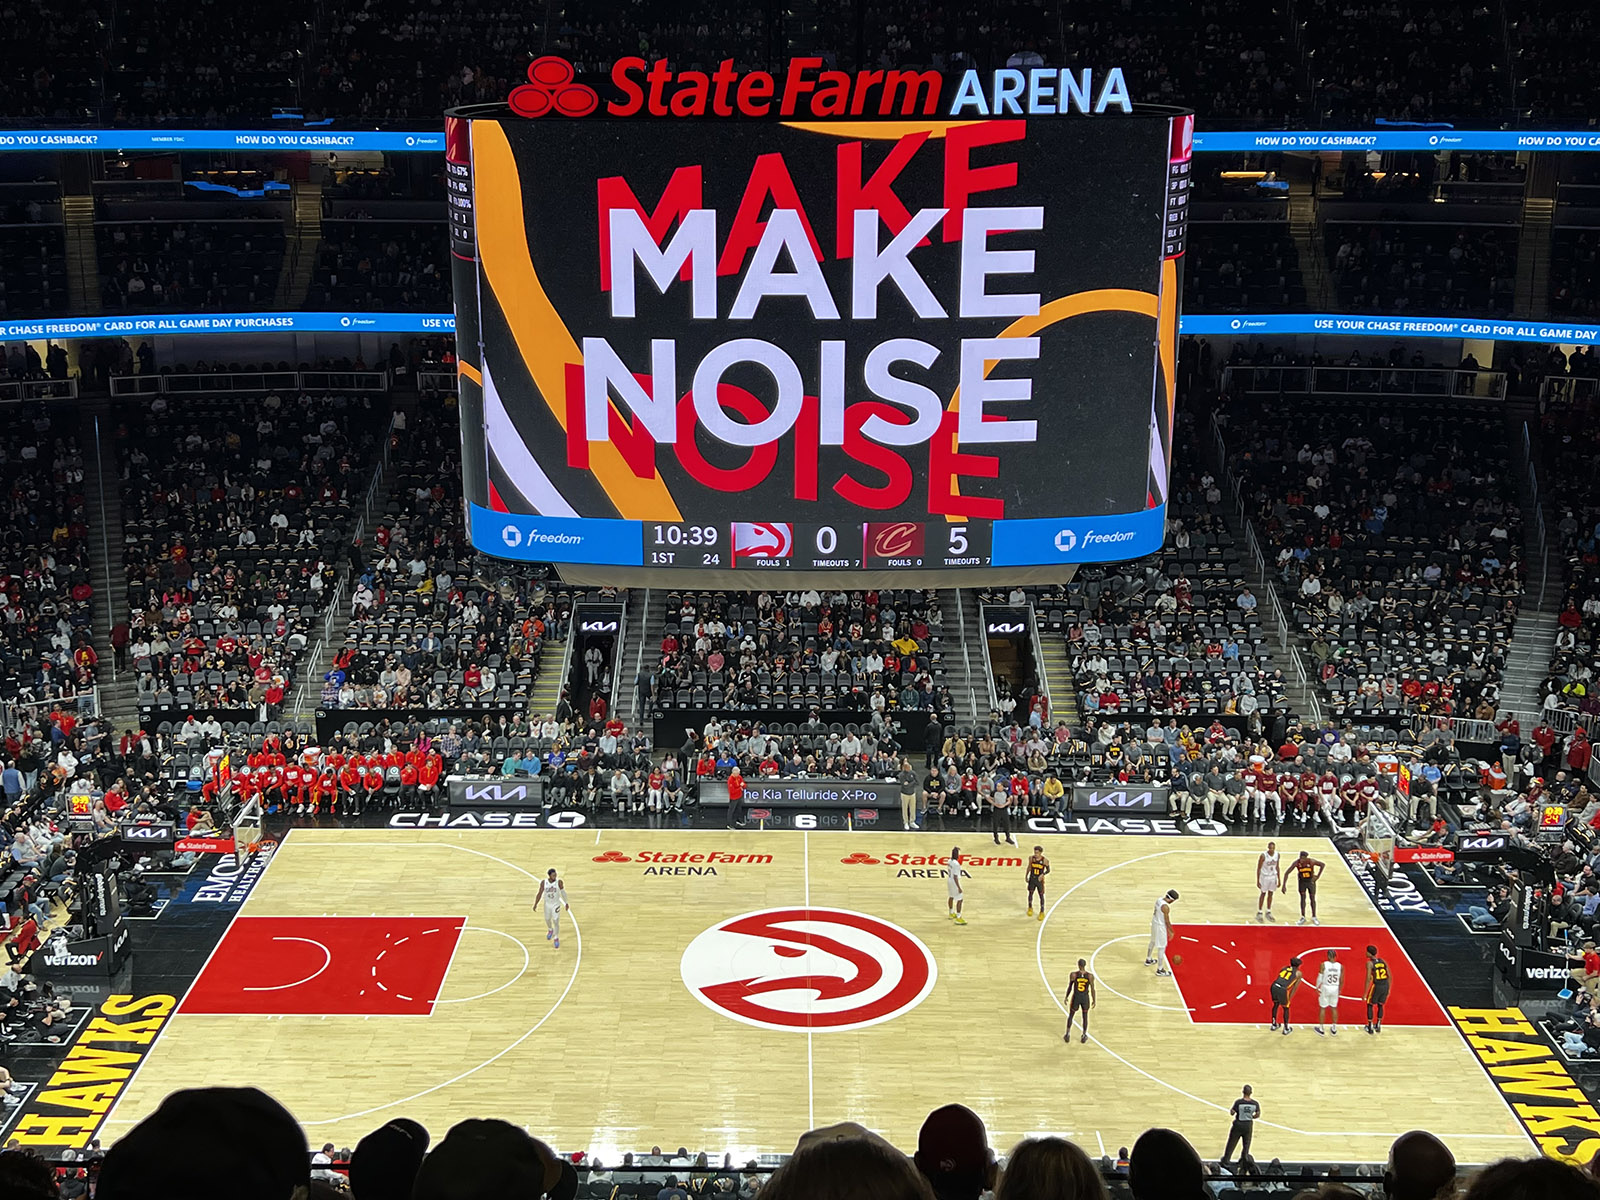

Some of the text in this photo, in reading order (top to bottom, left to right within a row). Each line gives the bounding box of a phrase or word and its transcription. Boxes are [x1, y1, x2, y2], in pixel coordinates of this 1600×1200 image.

[949, 68, 1133, 115] ARENA
[0, 136, 98, 145] DO YOU CASHBACK?
[236, 136, 354, 145] HOW DO YOU CASHBACK?
[1256, 136, 1376, 145] HOW DO YOU CASHBACK?
[1518, 137, 1544, 145] HOW
[1546, 137, 1562, 145] DO
[1565, 137, 1586, 145] YOU
[609, 207, 1044, 319] MAKE
[9, 325, 44, 335] CHASE
[104, 321, 133, 331] CARD
[136, 320, 156, 330] FOR
[158, 320, 177, 329] ALL
[179, 319, 210, 328] GAME
[212, 319, 233, 328] DAY
[235, 317, 293, 327] PURCHASES
[422, 319, 440, 327] USE
[1314, 320, 1334, 328] USE
[1336, 320, 1365, 329] YOUR
[1367, 321, 1401, 331] CHASE
[1461, 324, 1490, 334] CARD
[1493, 326, 1514, 335] FOR
[1516, 327, 1536, 337] ALL
[1539, 328, 1572, 338] GAME
[1574, 330, 1597, 340] DAY
[583, 337, 1040, 446] NOISE
[654, 525, 717, 546] 10:39
[816, 526, 837, 554] 0
[949, 527, 968, 554] 5
[652, 552, 719, 565] 1ST 24
[757, 559, 780, 567] FOULS
[888, 559, 911, 567] FOULS
[985, 557, 991, 565] 7
[744, 789, 877, 801] he Kia Telluride X-Pro
[389, 812, 540, 827] CHASE
[795, 814, 817, 828] 6
[1027, 817, 1181, 835] CHASE
[643, 866, 718, 876] ARENA
[44, 952, 97, 966] verizon
[1280, 970, 1292, 980] 41
[1327, 974, 1338, 983] 35
[1375, 968, 1387, 980] 12
[1526, 965, 1571, 979] verizo
[1077, 982, 1086, 992] 5
[2, 994, 177, 1148] HAWKS
[1447, 1006, 1600, 1166] HAWKS
